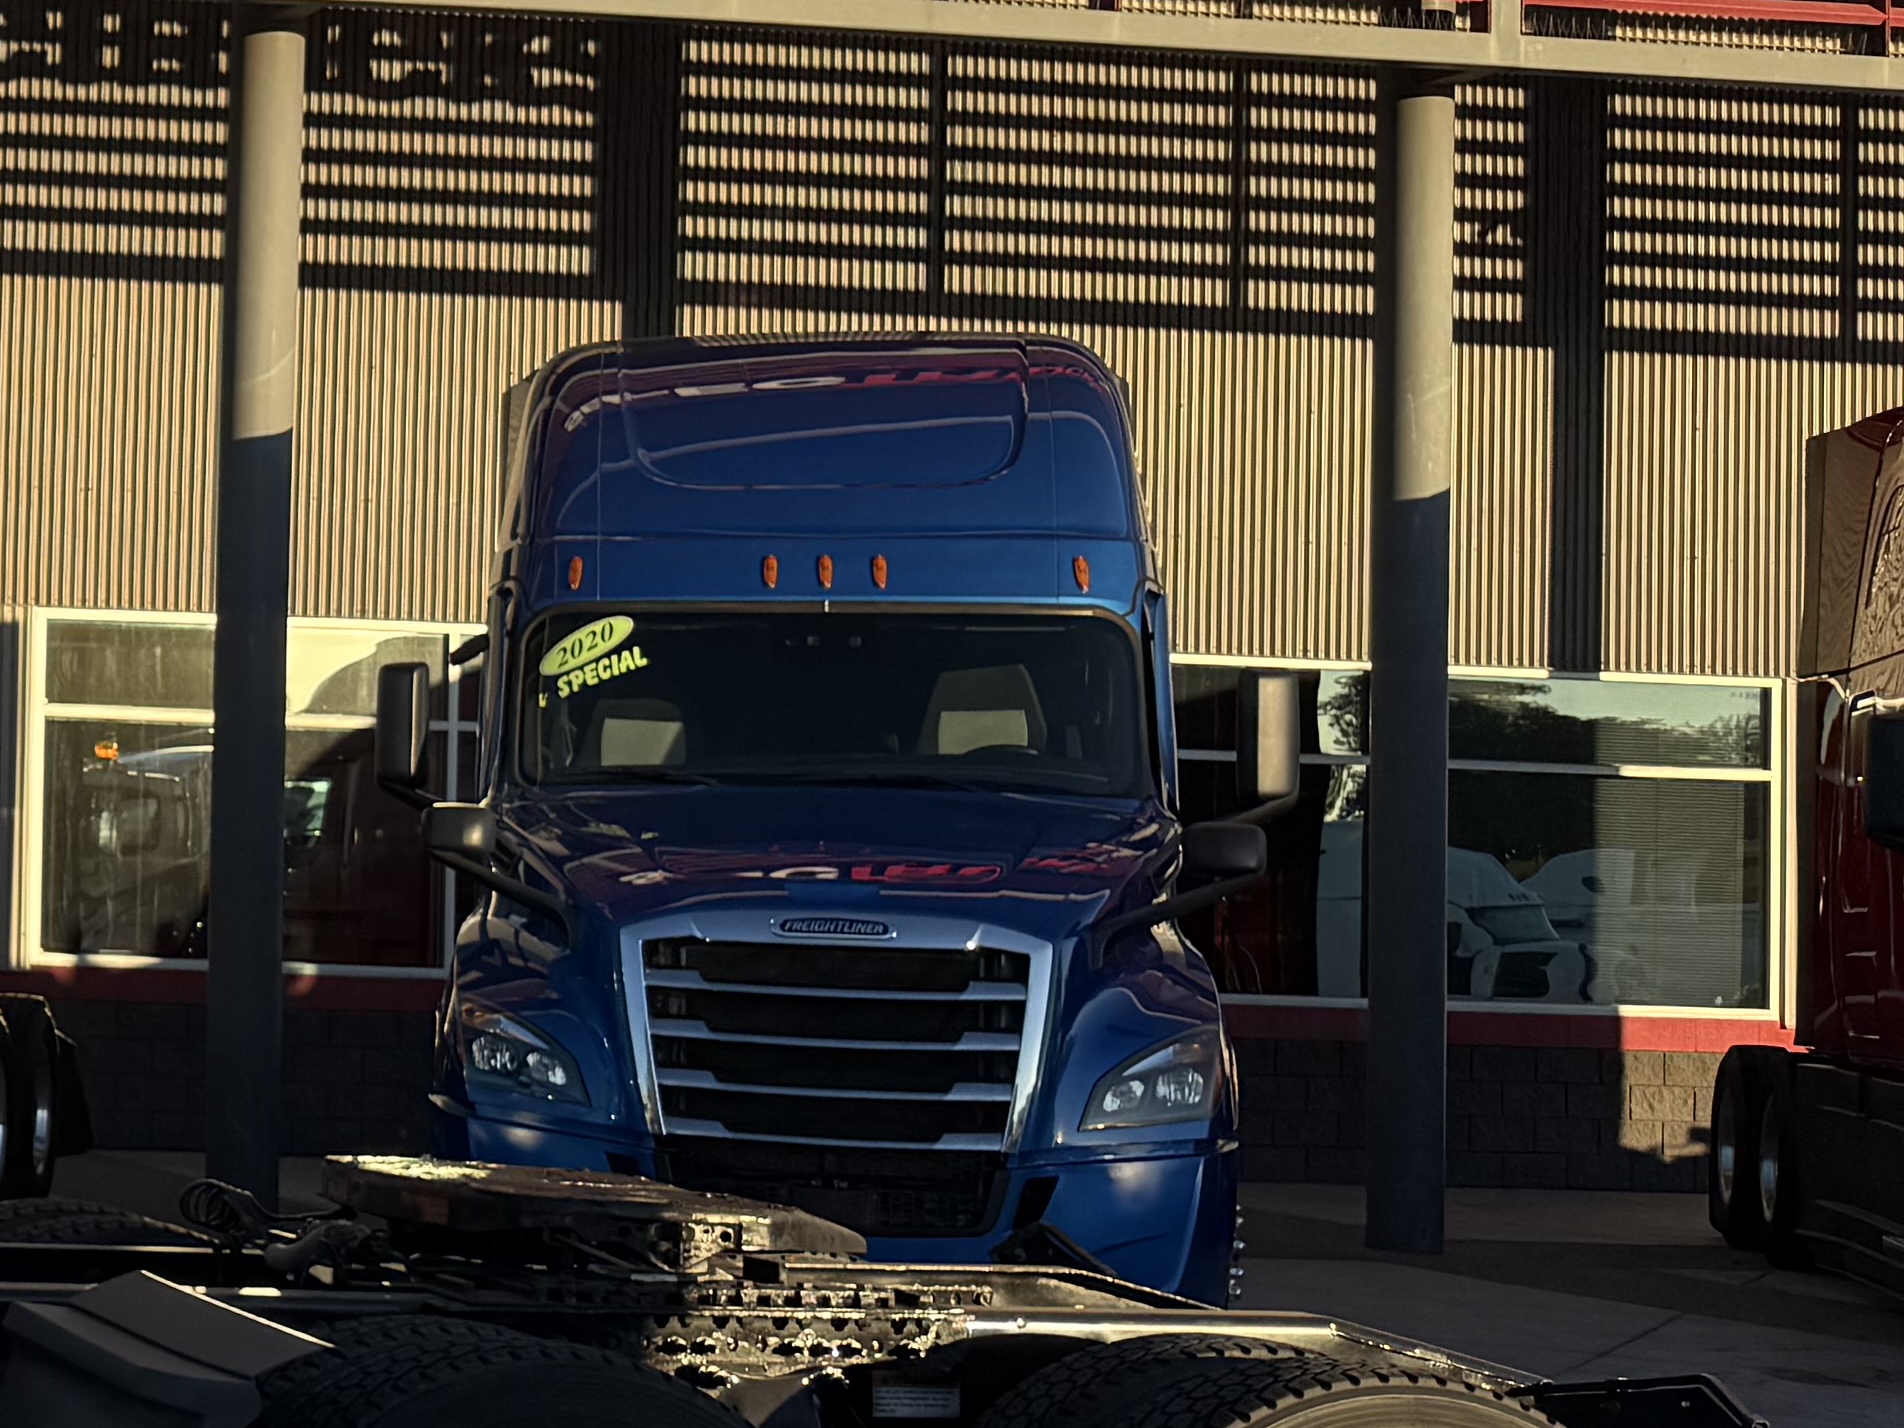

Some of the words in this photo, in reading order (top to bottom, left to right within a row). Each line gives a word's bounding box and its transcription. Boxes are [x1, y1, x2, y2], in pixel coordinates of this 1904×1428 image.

[556, 620, 614, 669] 2020
[556, 645, 649, 699] SPECIAL
[784, 919, 884, 934] FREIGHTLINER
